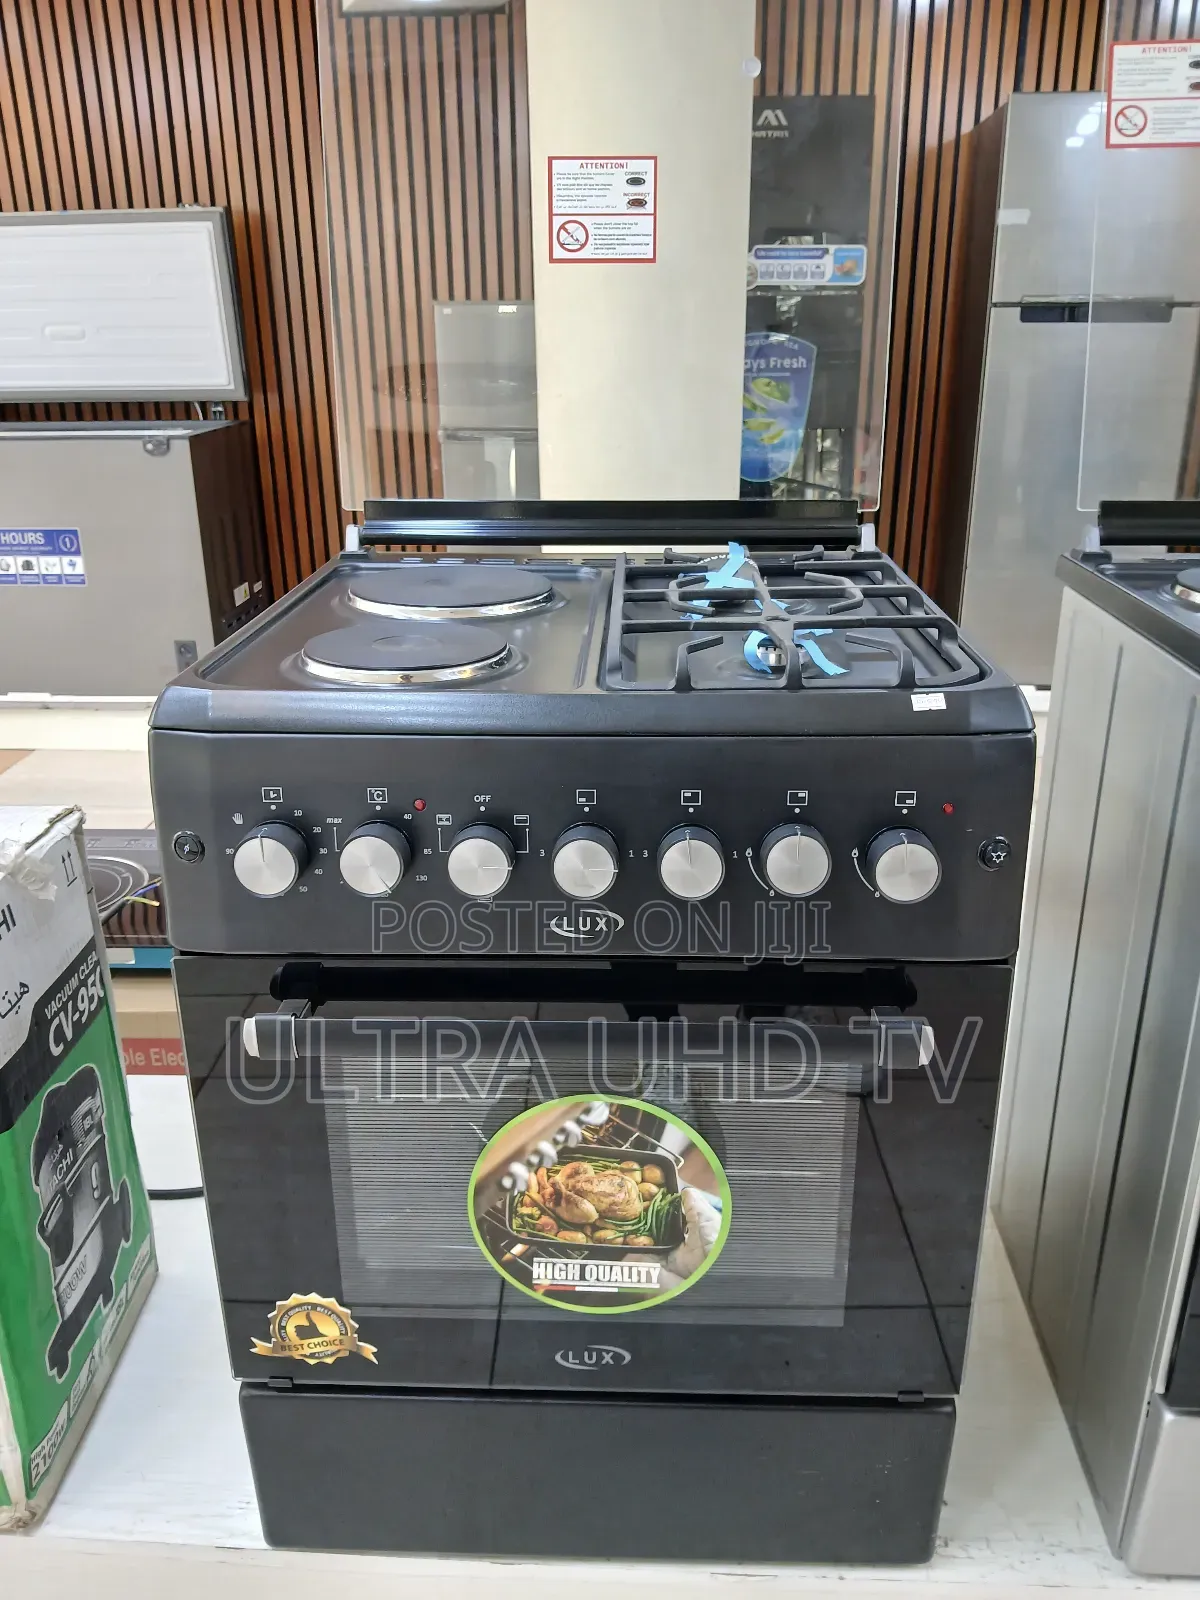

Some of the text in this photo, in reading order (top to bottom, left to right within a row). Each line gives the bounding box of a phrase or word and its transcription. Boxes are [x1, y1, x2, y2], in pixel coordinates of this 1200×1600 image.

[1141, 46, 1192, 54] ATTENTION!
[770, 356, 807, 368] Fresh
[0, 532, 46, 545] HOURS
[474, 794, 492, 803] OFF
[326, 816, 343, 824] max
[540, 849, 546, 857] 3
[628, 850, 634, 858] 1
[642, 850, 648, 858] 3
[732, 850, 738, 858] 1
[562, 916, 609, 932] LUX
[44, 972, 79, 1020] VACUUM
[532, 1262, 661, 1284] HIGH QUALITY
[316, 1306, 331, 1316] BEST
[280, 1338, 345, 1352] BEST CHOICE
[568, 1350, 614, 1364] LUX
